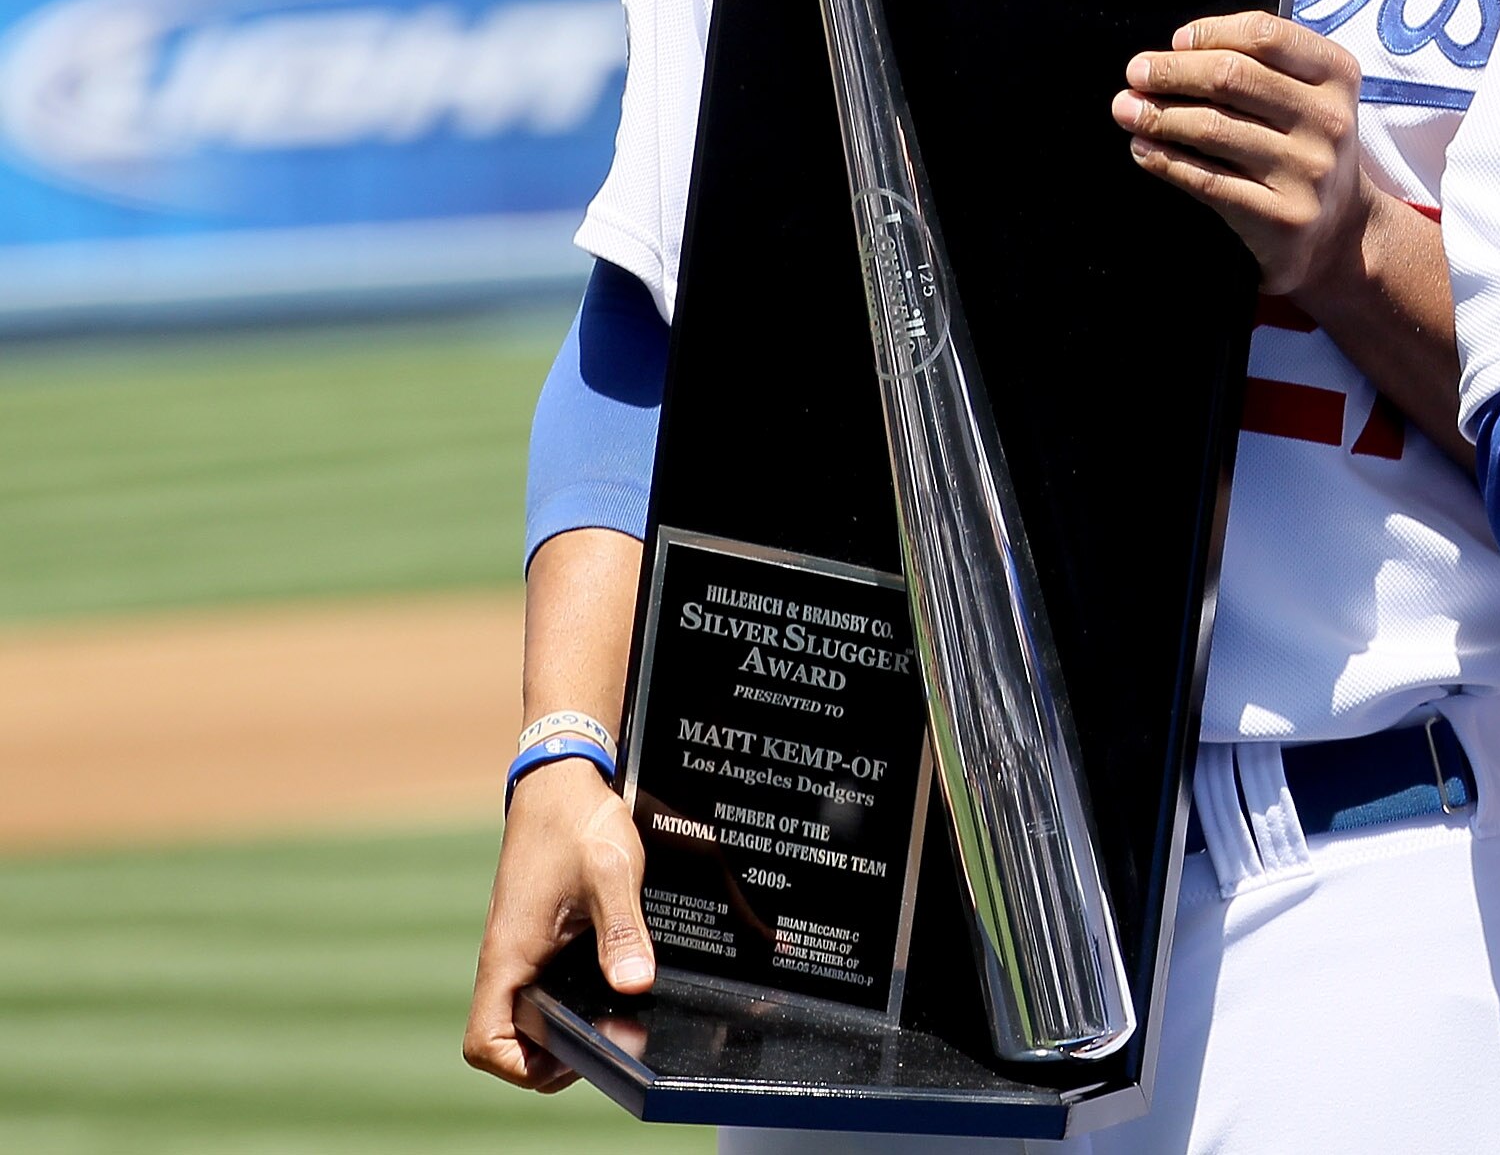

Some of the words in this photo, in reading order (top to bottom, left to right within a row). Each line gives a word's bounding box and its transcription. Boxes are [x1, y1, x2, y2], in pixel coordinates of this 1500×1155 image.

[917, 261, 937, 297] 125
[680, 601, 779, 647] SILVER
[706, 584, 783, 616] HILLERICH
[786, 602, 800, 619] &
[802, 604, 869, 634] BRADSBY
[871, 619, 894, 639] CO.
[738, 646, 847, 691] AWARD
[733, 684, 822, 714] PRESENTED
[824, 704, 844, 719] TO
[677, 718, 757, 754] MATT
[761, 735, 888, 782] KEMP-OF
[682, 751, 715, 773] Los
[718, 759, 792, 789] Angeles
[796, 775, 875, 807] Dodgers
[714, 802, 775, 830] MEMBER
[778, 816, 799, 835] OF
[801, 820, 830, 842] THE
[652, 812, 717, 842] NATIONAL
[720, 827, 772, 854] LEAGUE
[775, 840, 848, 870] OFFENSIVE
[850, 855, 887, 877] TEAM
[741, 867, 792, 890] -2009-
[645, 901, 671, 916] HASE
[673, 907, 716, 925] UTLEY-2B
[679, 895, 729, 915] PUJOLS-1B
[647, 915, 677, 931] ANLEY
[678, 922, 734, 943] RAMIREZ-SS
[777, 915, 807, 932] BRIAN
[663, 933, 737, 958] ZIMMERMAN-3B
[774, 942, 808, 959] ANDRE
[808, 949, 859, 969] ETHIER-OF
[775, 929, 802, 944] RYAN
[803, 934, 852, 955] BRAUN-OF
[772, 956, 810, 973] CARLOS
[811, 964, 874, 987] ZAMBRANO-P
